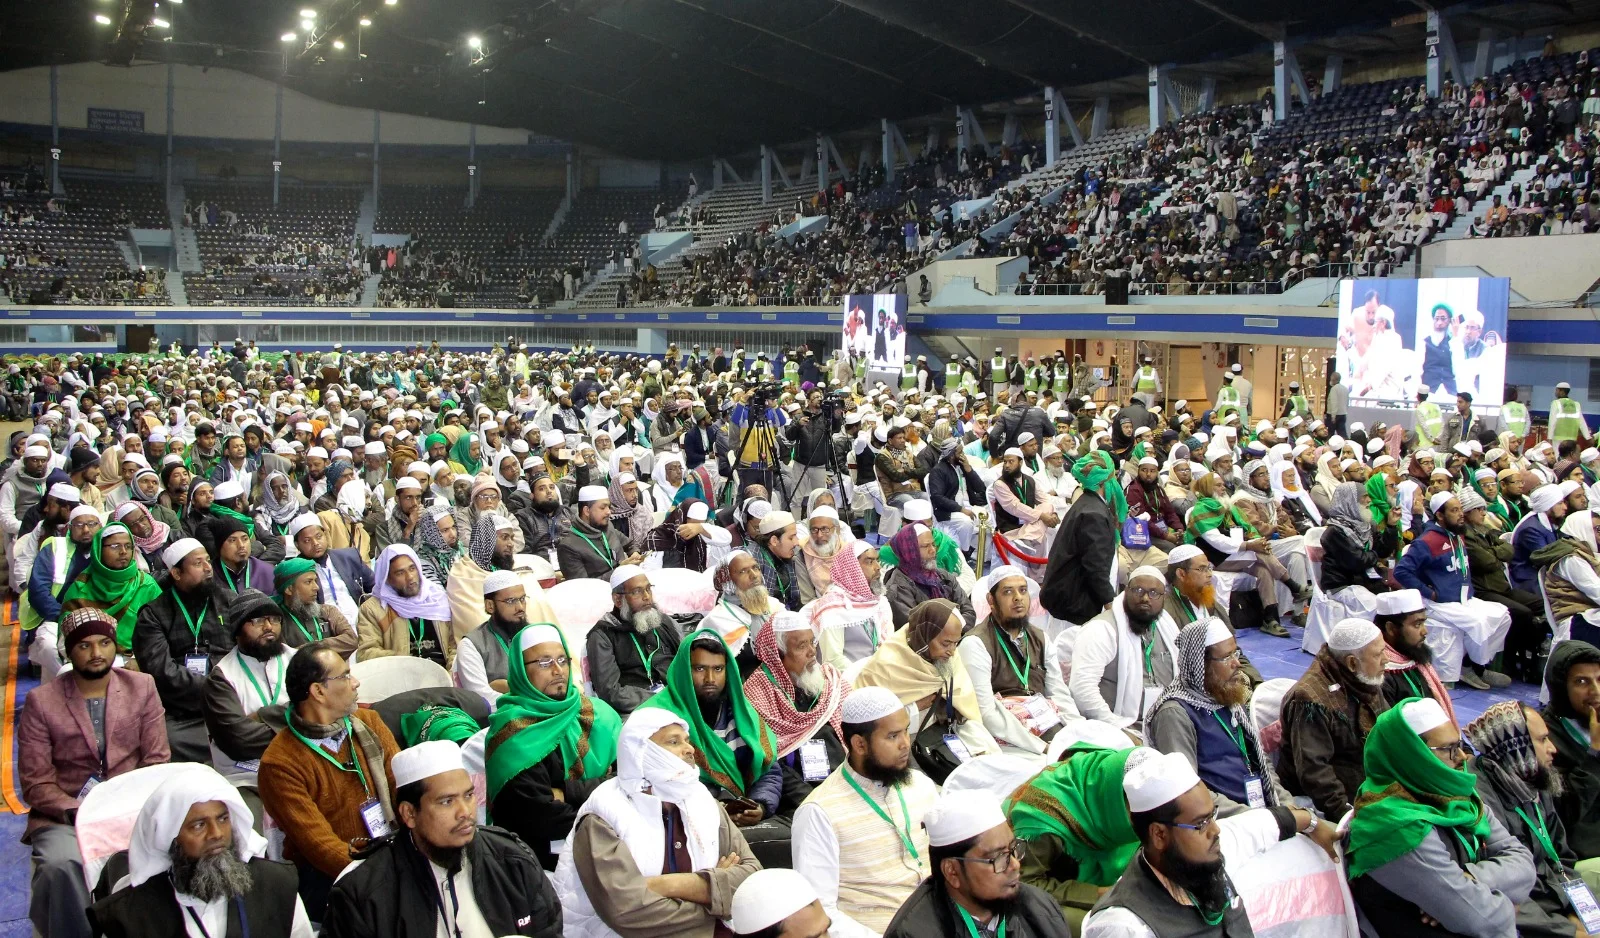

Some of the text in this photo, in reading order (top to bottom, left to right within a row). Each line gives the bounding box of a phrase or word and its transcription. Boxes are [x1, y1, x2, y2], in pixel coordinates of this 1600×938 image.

[1428, 45, 1437, 57] A
[1046, 111, 1052, 119] V
[52, 152, 60, 160] Q
